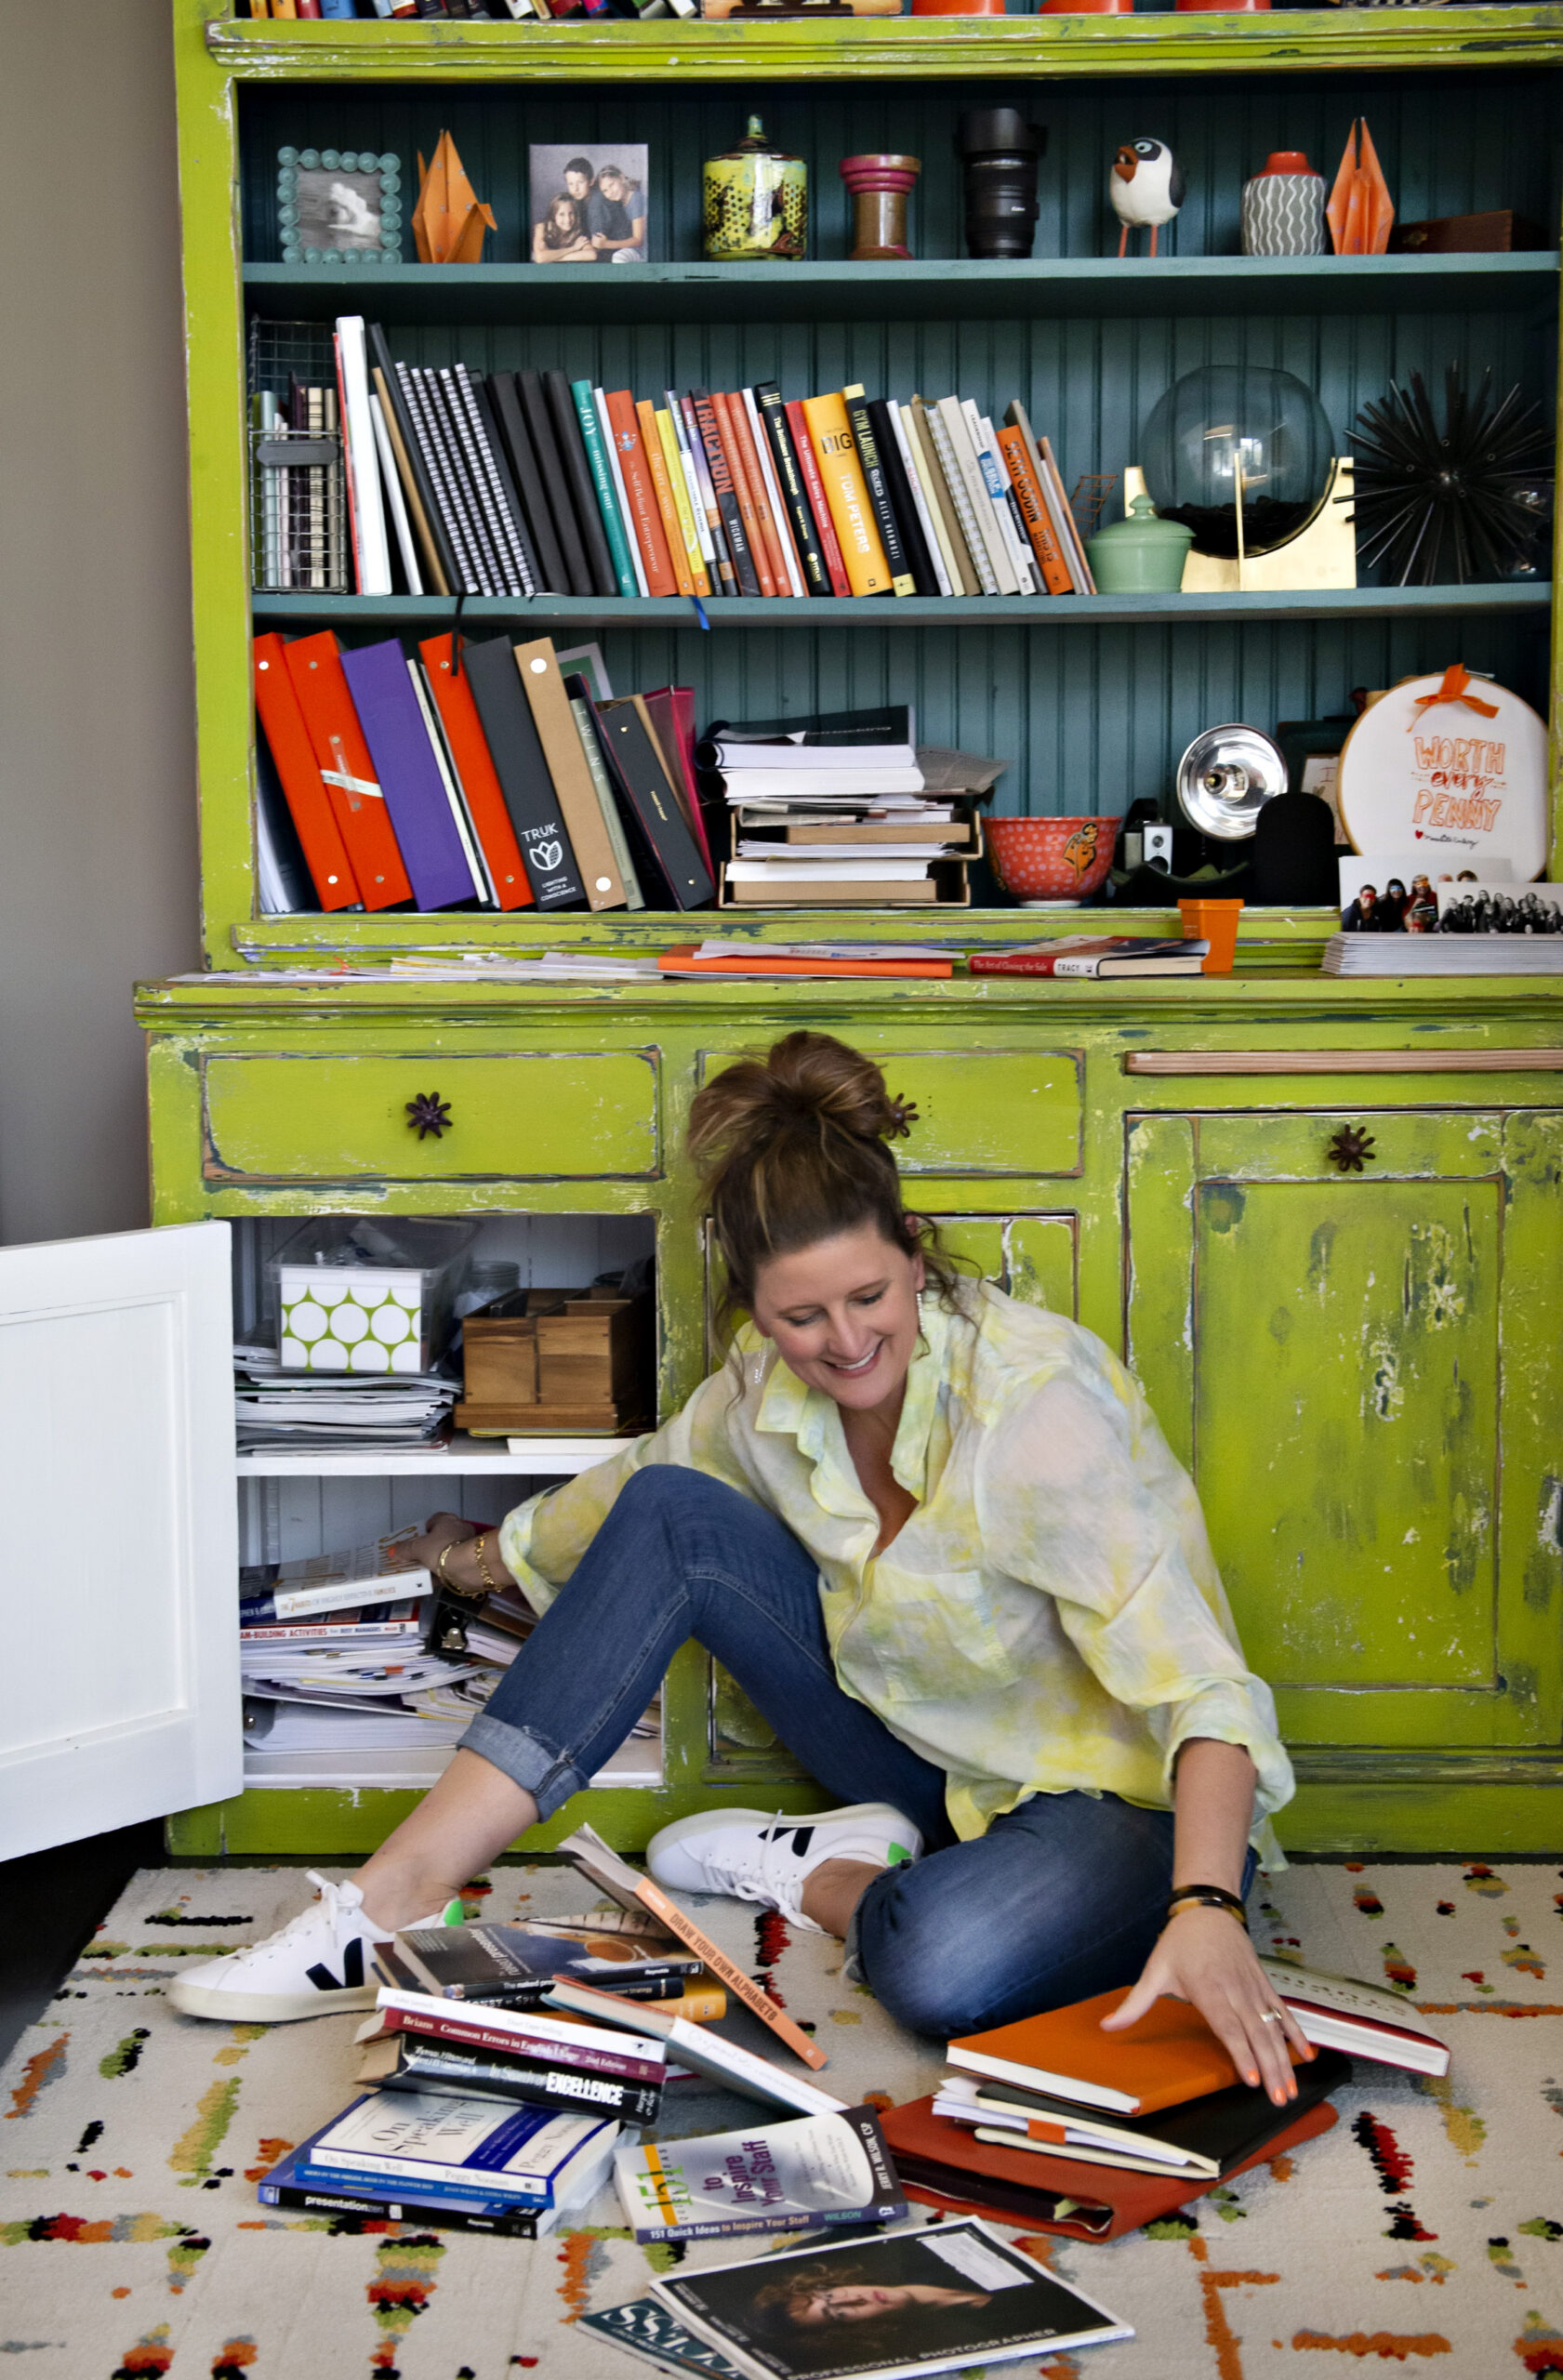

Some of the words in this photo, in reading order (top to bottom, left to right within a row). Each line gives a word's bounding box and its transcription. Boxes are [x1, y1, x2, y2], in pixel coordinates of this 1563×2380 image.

[773, 416, 782, 428] The
[851, 408, 869, 430] GYM
[693, 396, 734, 495] TRACTION
[717, 406, 732, 437] WORTH
[725, 440, 739, 467] EVERY
[733, 468, 748, 496] PENNY
[731, 406, 747, 438] WORTH
[740, 440, 754, 466] EVERY
[748, 468, 762, 496] PENNY
[775, 428, 789, 456] Brilliance
[799, 434, 808, 445] The
[819, 430, 854, 456] BIG
[856, 430, 880, 469] LAUNCH
[578, 404, 597, 436] JOY
[589, 448, 609, 490] missing
[602, 492, 613, 509] out
[651, 452, 664, 470] the
[802, 449, 816, 480] Ultimate
[655, 470, 667, 486] art
[781, 456, 799, 496] Breakthrough
[810, 480, 821, 499] Sales
[839, 472, 857, 502] TOM
[1003, 440, 1027, 477] SETH
[1015, 476, 1043, 523] GODIN
[660, 496, 674, 520] woo
[815, 499, 828, 528] Machine
[877, 499, 889, 520] ALEX
[728, 518, 744, 552] WICKMAN
[845, 503, 870, 554] PETERS
[638, 516, 661, 574] Entrepreneur
[574, 708, 605, 782] TWINS
[1413, 736, 1505, 774] WORTH
[1431, 772, 1494, 799] every
[1412, 790, 1502, 831] PENNY
[522, 823, 559, 841] TRUK
[1001, 961, 1023, 971] Closing
[288, 1597, 296, 1611] 7
[289, 1628, 327, 1637] ACTIVITIES
[669, 1912, 695, 1940] DRAW
[692, 1936, 716, 1961] YOUR
[711, 1955, 735, 1979] OWN
[730, 1973, 778, 2023] ALPHABETS
[516, 1979, 536, 1989] naked
[403, 2016, 434, 2030] Brians
[440, 2023, 480, 2040] Common
[482, 2031, 510, 2046] Errors
[510, 2038, 520, 2048] in
[519, 2040, 552, 2056] English
[599, 2057, 627, 2070] Edition
[545, 2070, 625, 2107] EXCELLENCE
[372, 2122, 410, 2142] On
[387, 2098, 468, 2154] Speaking
[436, 2112, 484, 2136] Well
[860, 2122, 873, 2135] CSP
[738, 2138, 778, 2175] Staff
[866, 2135, 881, 2163] WILSON,
[636, 2165, 693, 2210] 151
[703, 2177, 724, 2191] to
[722, 2155, 756, 2203] Inspire
[757, 2175, 788, 2208] Your
[877, 2171, 893, 2188] JERRY
[650, 2229, 665, 2239] 151
[667, 2227, 694, 2238] Quick
[695, 2224, 720, 2234] Ideas
[721, 2223, 731, 2231] to
[732, 2219, 763, 2232] Inspire
[766, 2216, 787, 2228] Your
[788, 2215, 809, 2225] Staff
[823, 2209, 861, 2221] WILSON
[788, 2356, 918, 2380] PROFESSIONAL
[919, 2328, 1058, 2360] PHOTOGRAPHER
